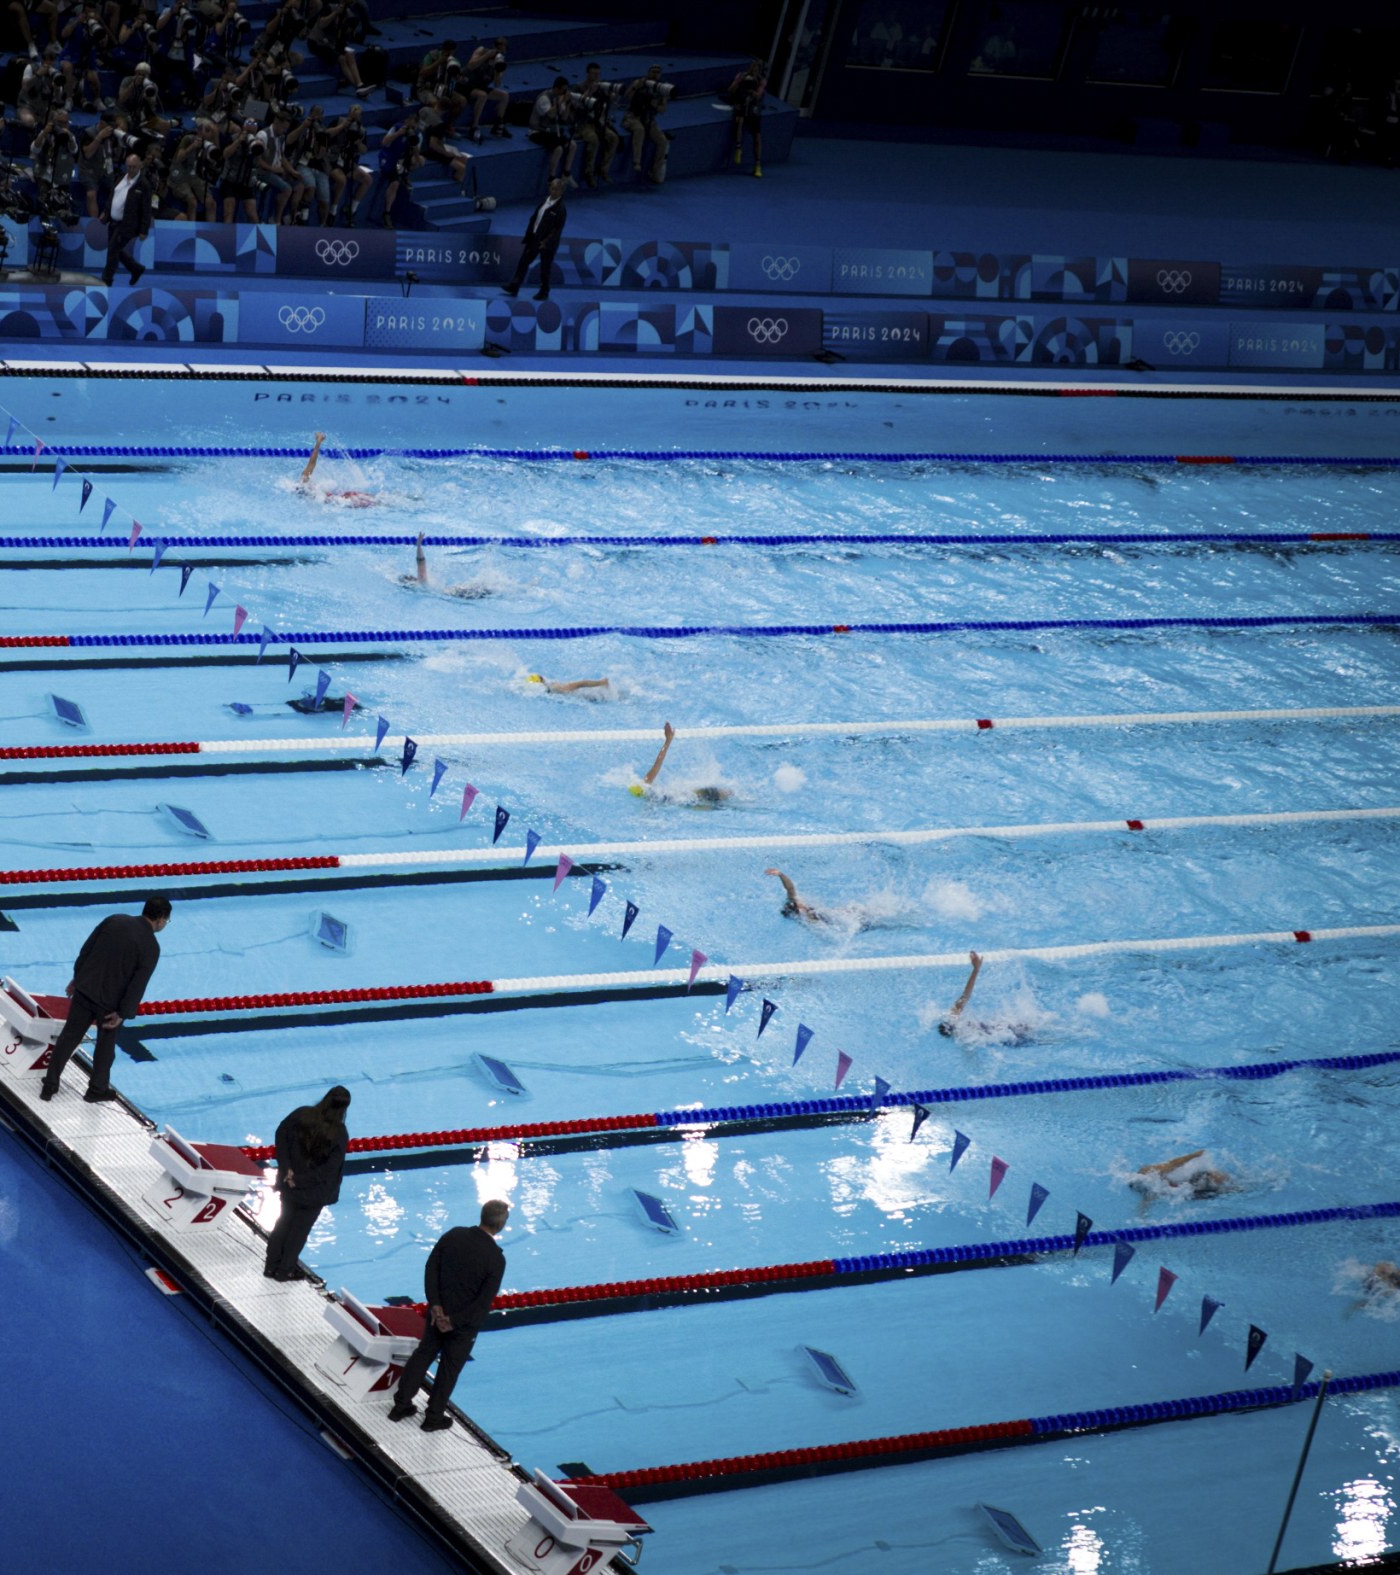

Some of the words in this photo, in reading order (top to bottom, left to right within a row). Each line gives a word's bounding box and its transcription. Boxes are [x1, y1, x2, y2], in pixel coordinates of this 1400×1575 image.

[405, 248, 453, 263] PARIS
[458, 250, 500, 265] 2024
[888, 266, 925, 279] 2024
[1227, 278, 1266, 292] PARIS
[1269, 279, 1304, 293] 2024
[376, 315, 426, 330] PARIS
[432, 317, 476, 331] 2024
[831, 326, 876, 341] PARIS
[881, 327, 920, 342] 2024
[1282, 339, 1317, 353] 2024
[5, 1035, 23, 1055] 3
[164, 1186, 184, 1209] 2
[202, 1202, 217, 1219] 2
[386, 1369, 395, 1387] 1
[580, 1554, 593, 1573] 0
